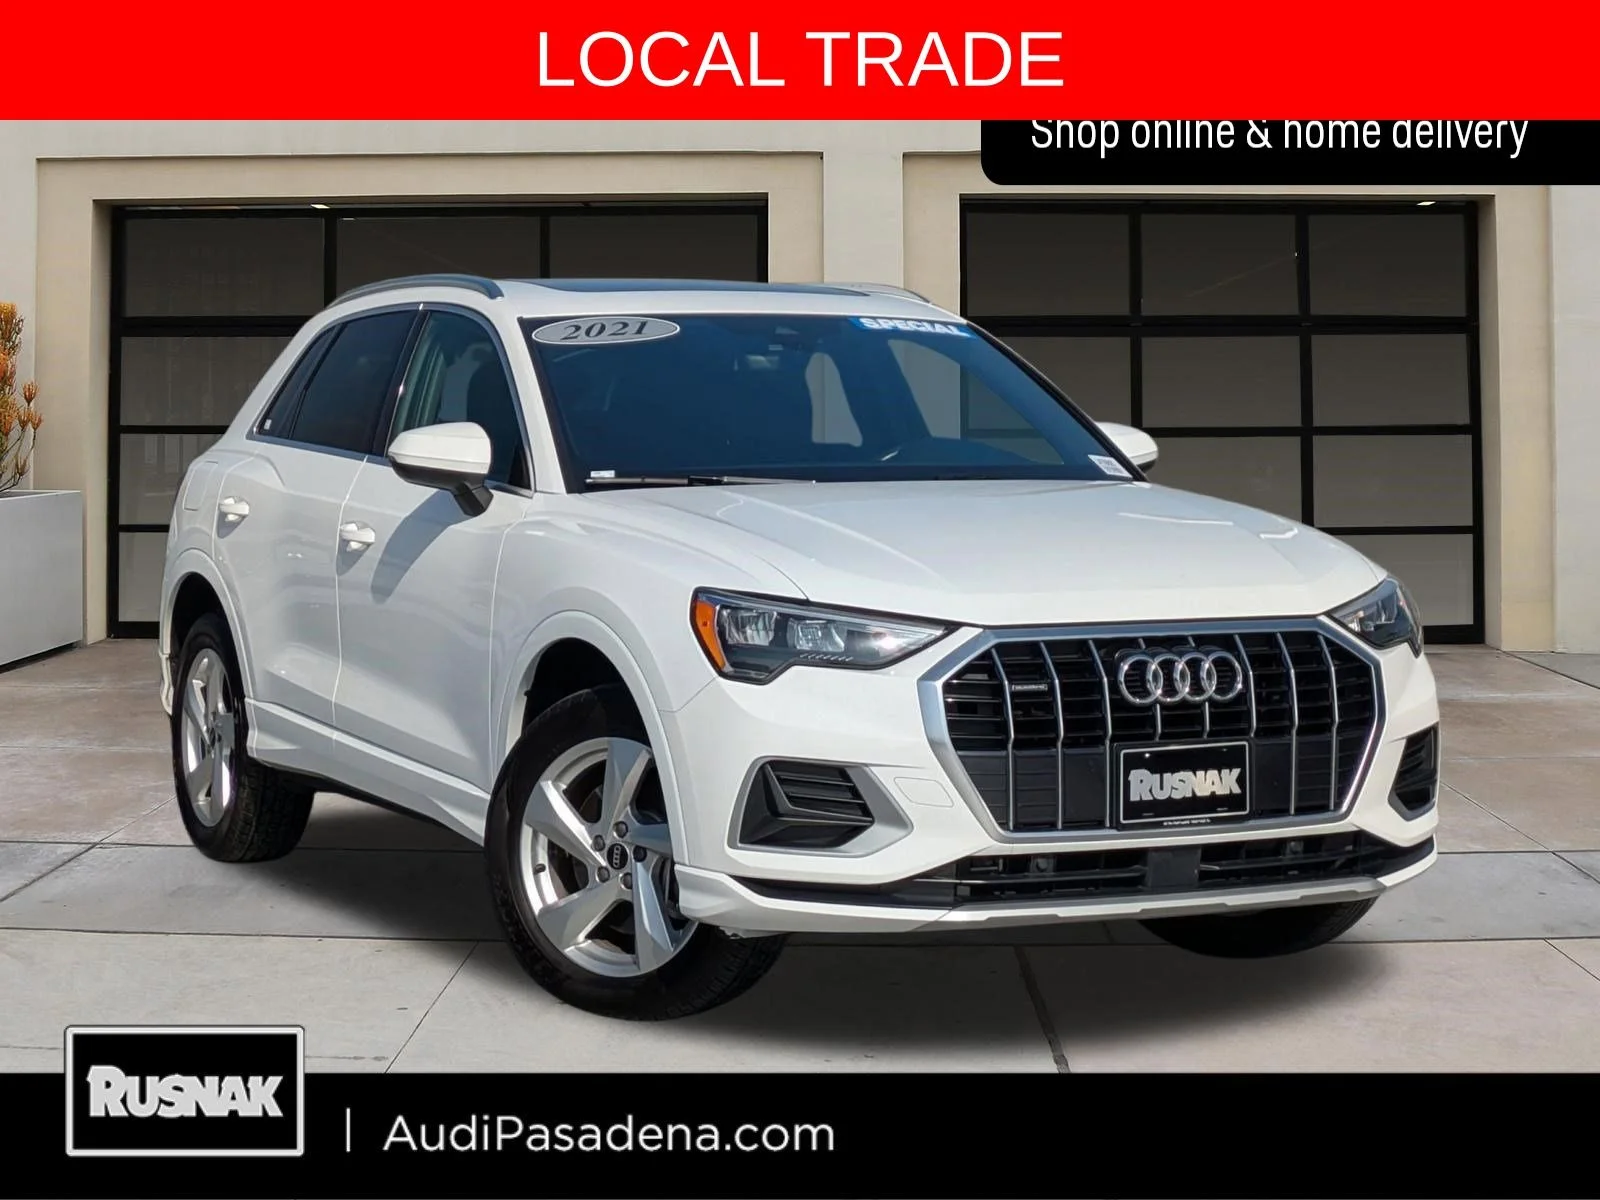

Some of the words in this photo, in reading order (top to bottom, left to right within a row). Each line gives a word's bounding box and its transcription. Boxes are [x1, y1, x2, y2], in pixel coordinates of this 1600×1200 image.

[560, 320, 649, 341] 2021
[858, 317, 969, 337] SPECIAL
[1128, 768, 1242, 802] RUSNAK
